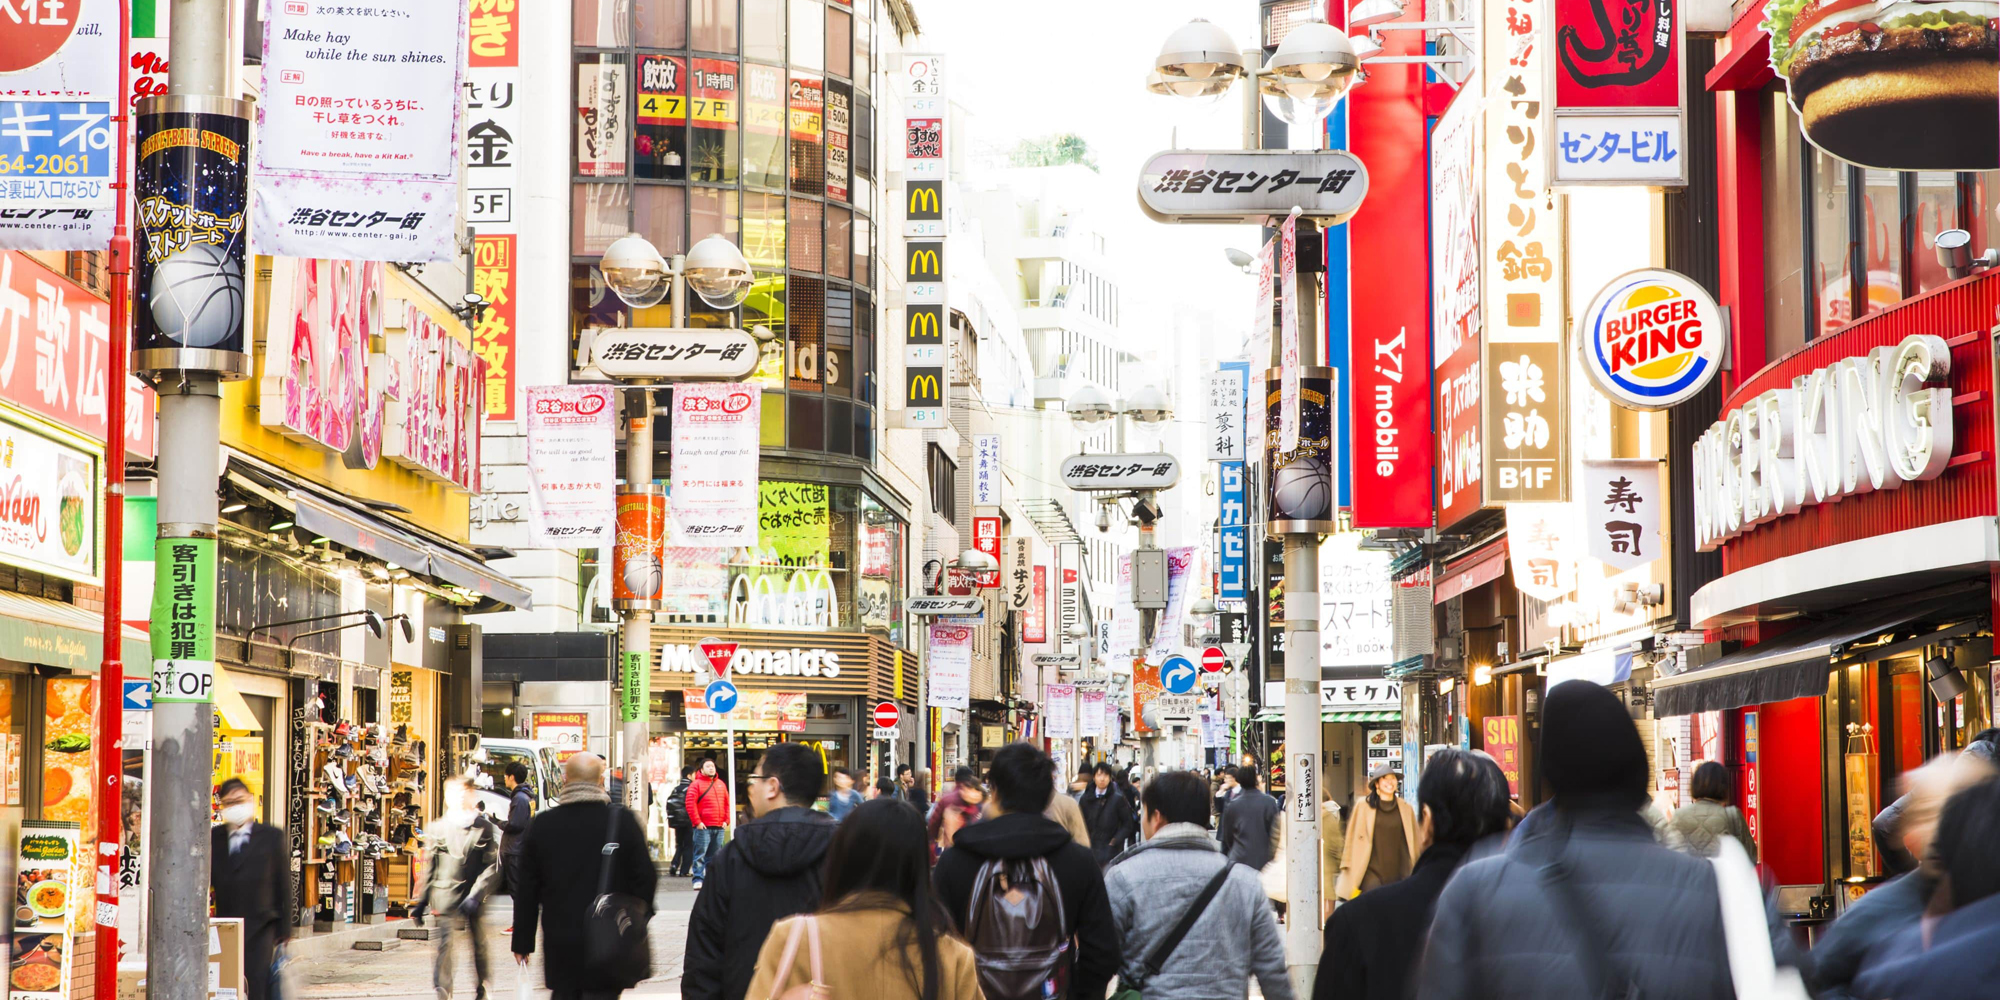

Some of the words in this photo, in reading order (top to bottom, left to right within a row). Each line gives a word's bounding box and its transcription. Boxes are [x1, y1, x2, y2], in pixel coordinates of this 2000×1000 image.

[287, 4, 305, 13] 問題
[283, 28, 321, 43] Make
[325, 31, 350, 46] hay
[131, 52, 169, 74] Mi
[305, 48, 342, 61] while
[346, 50, 368, 62] the
[372, 54, 396, 63] sun
[401, 51, 446, 64] shines.
[284, 72, 301, 82] 正解
[642, 59, 676, 90] 飲放
[694, 70, 734, 91] 1時間
[791, 80, 822, 102] 2時間
[912, 79, 926, 94] 金
[295, 95, 425, 112] 日の照っているうちに、
[313, 112, 405, 128] 干し草をつくれ。
[140, 128, 199, 162] BASKETBALL
[200, 129, 240, 163] STREET
[300, 150, 320, 158] Have
[328, 150, 352, 159] break,
[354, 152, 373, 160] have
[1560, 130, 1678, 164] センタービル
[1154, 169, 1356, 194] 渋谷センター街
[473, 195, 504, 214] 5F
[288, 208, 426, 230] 渋谷センター街
[147, 229, 224, 262] ストリート
[1606, 299, 1698, 343] BURGER
[602, 342, 748, 361] 渋谷センター街
[1612, 319, 1702, 374] KING
[1499, 354, 1550, 450] 米助
[916, 411, 936, 420] B1
[1792, 334, 1953, 506] KING
[578, 448, 592, 457] good
[979, 439, 989, 502] 日本舞踊教室
[1067, 462, 1172, 478] 渋谷センター街
[1499, 467, 1553, 489] B1F
[1692, 388, 1788, 553] BURGER
[1604, 476, 1644, 556] 寿司
[545, 526, 603, 536] 渋谷センター街
[686, 524, 745, 534] 渋谷センター街
[1222, 466, 1243, 591] サカゼン
[1528, 518, 1560, 588] 寿司
[1013, 568, 1030, 608] 牛タン
[172, 544, 198, 660] 客引きは犯罪
[910, 601, 976, 609] 渋谷センター街
[660, 644, 840, 678] Mconald's
[708, 650, 732, 658] 止まれ
[629, 654, 641, 720] 客引きは犯罪です
[1162, 706, 1194, 715] 一方通行
